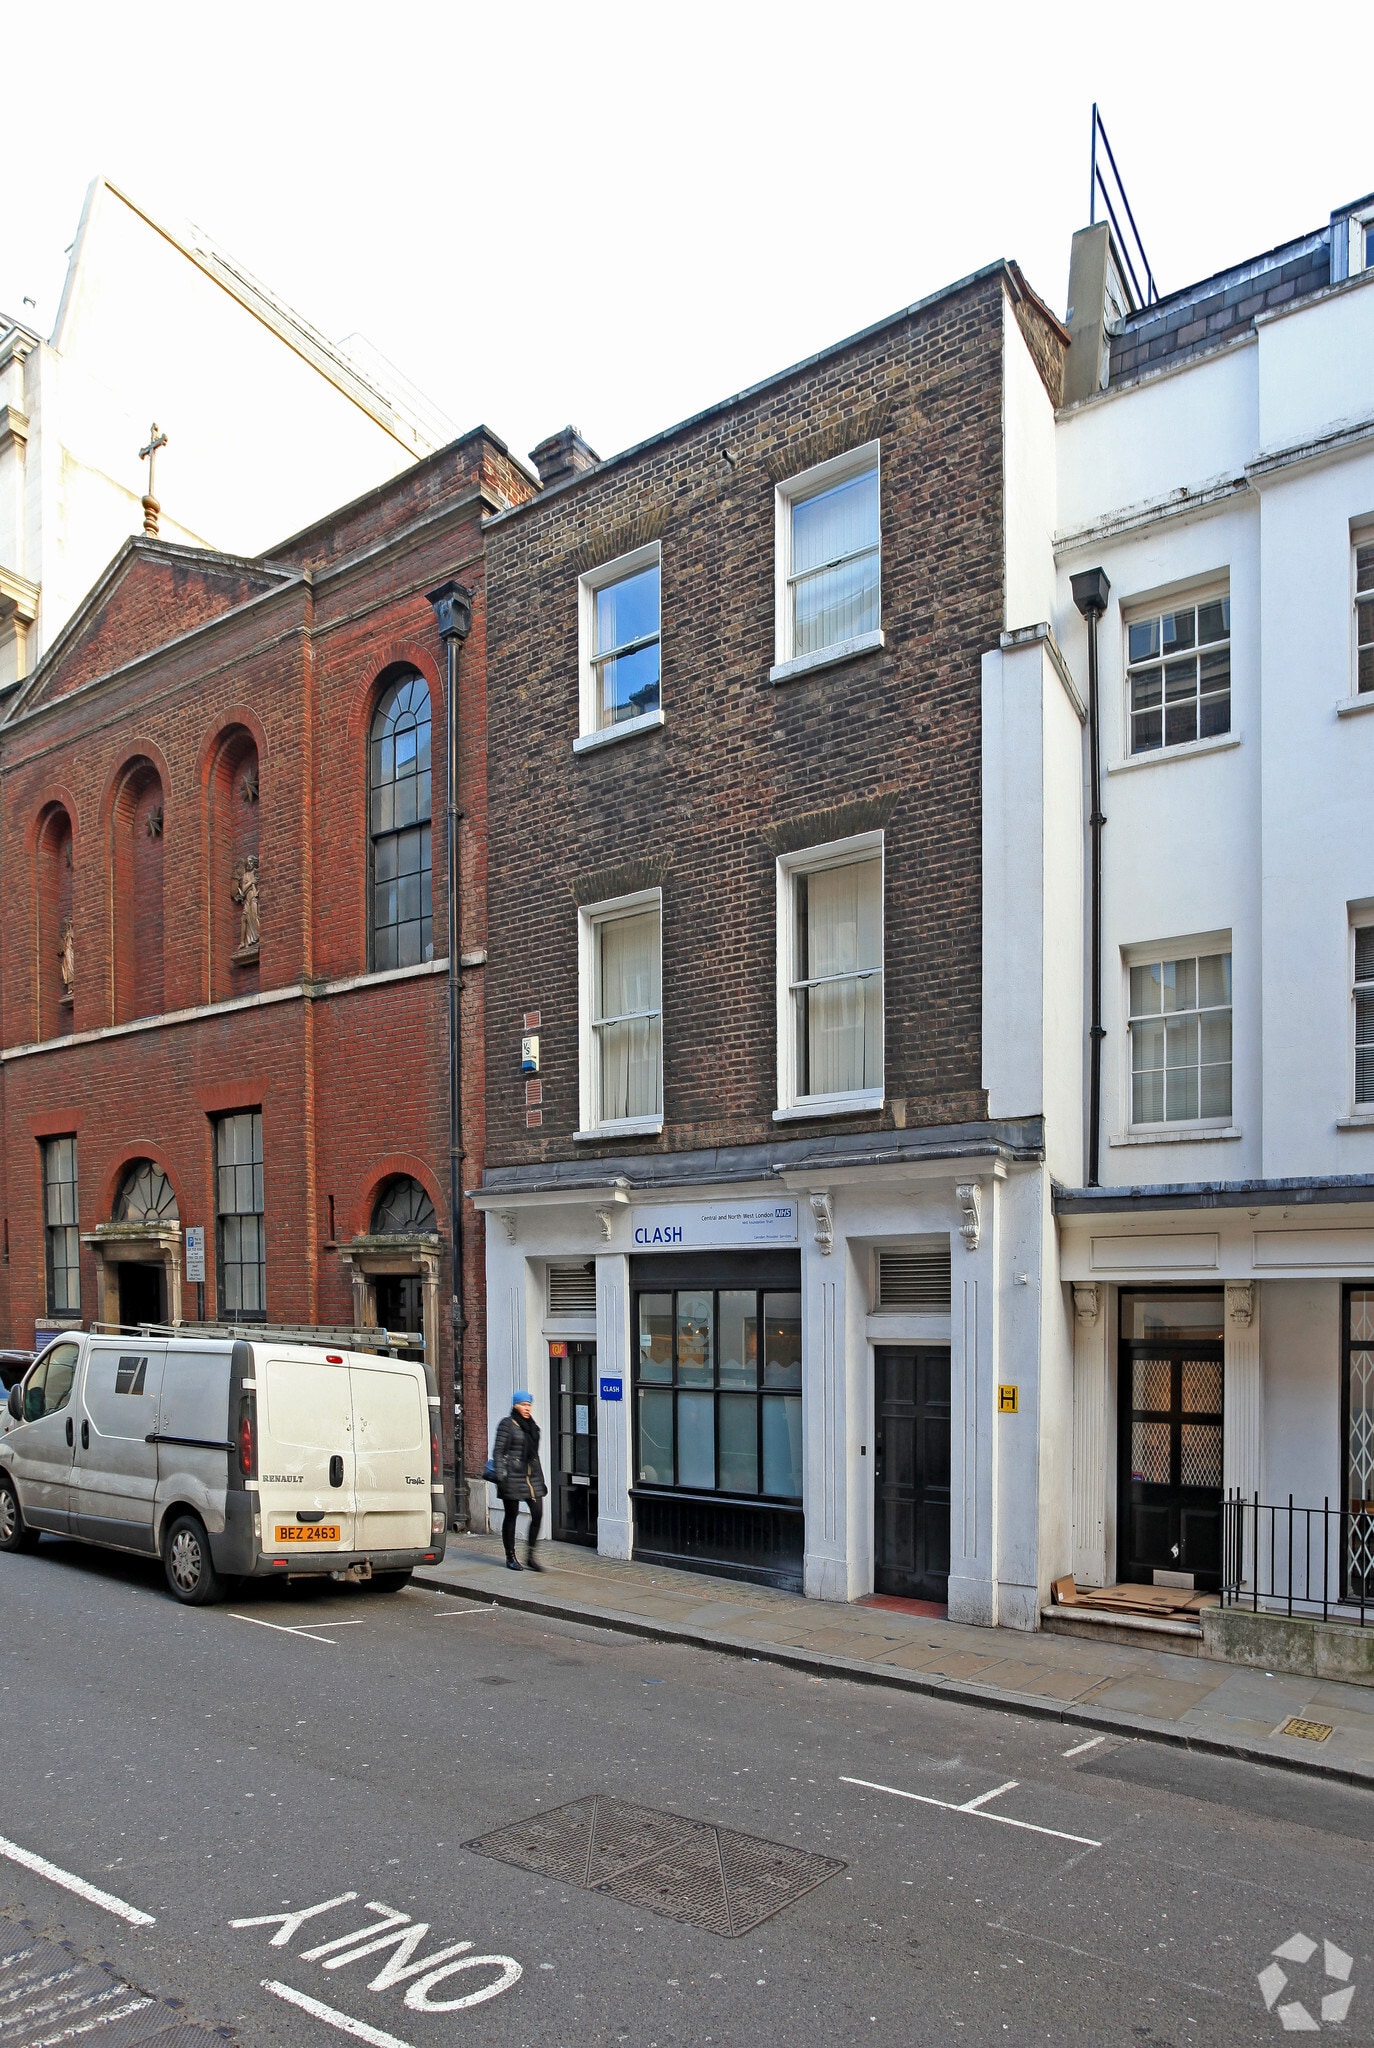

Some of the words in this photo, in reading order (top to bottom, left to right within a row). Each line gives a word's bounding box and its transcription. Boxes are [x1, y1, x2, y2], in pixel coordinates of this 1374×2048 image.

[775, 1208, 791, 1217] NHS
[635, 1226, 682, 1243] CLASH
[1001, 1388, 1015, 1409] H
[262, 1475, 304, 1483] RENAULT
[405, 1476, 425, 1485] Trafic
[280, 1527, 303, 1540] BEZ
[307, 1527, 336, 1539] 2463
[227, 1891, 523, 2012] ONLY
